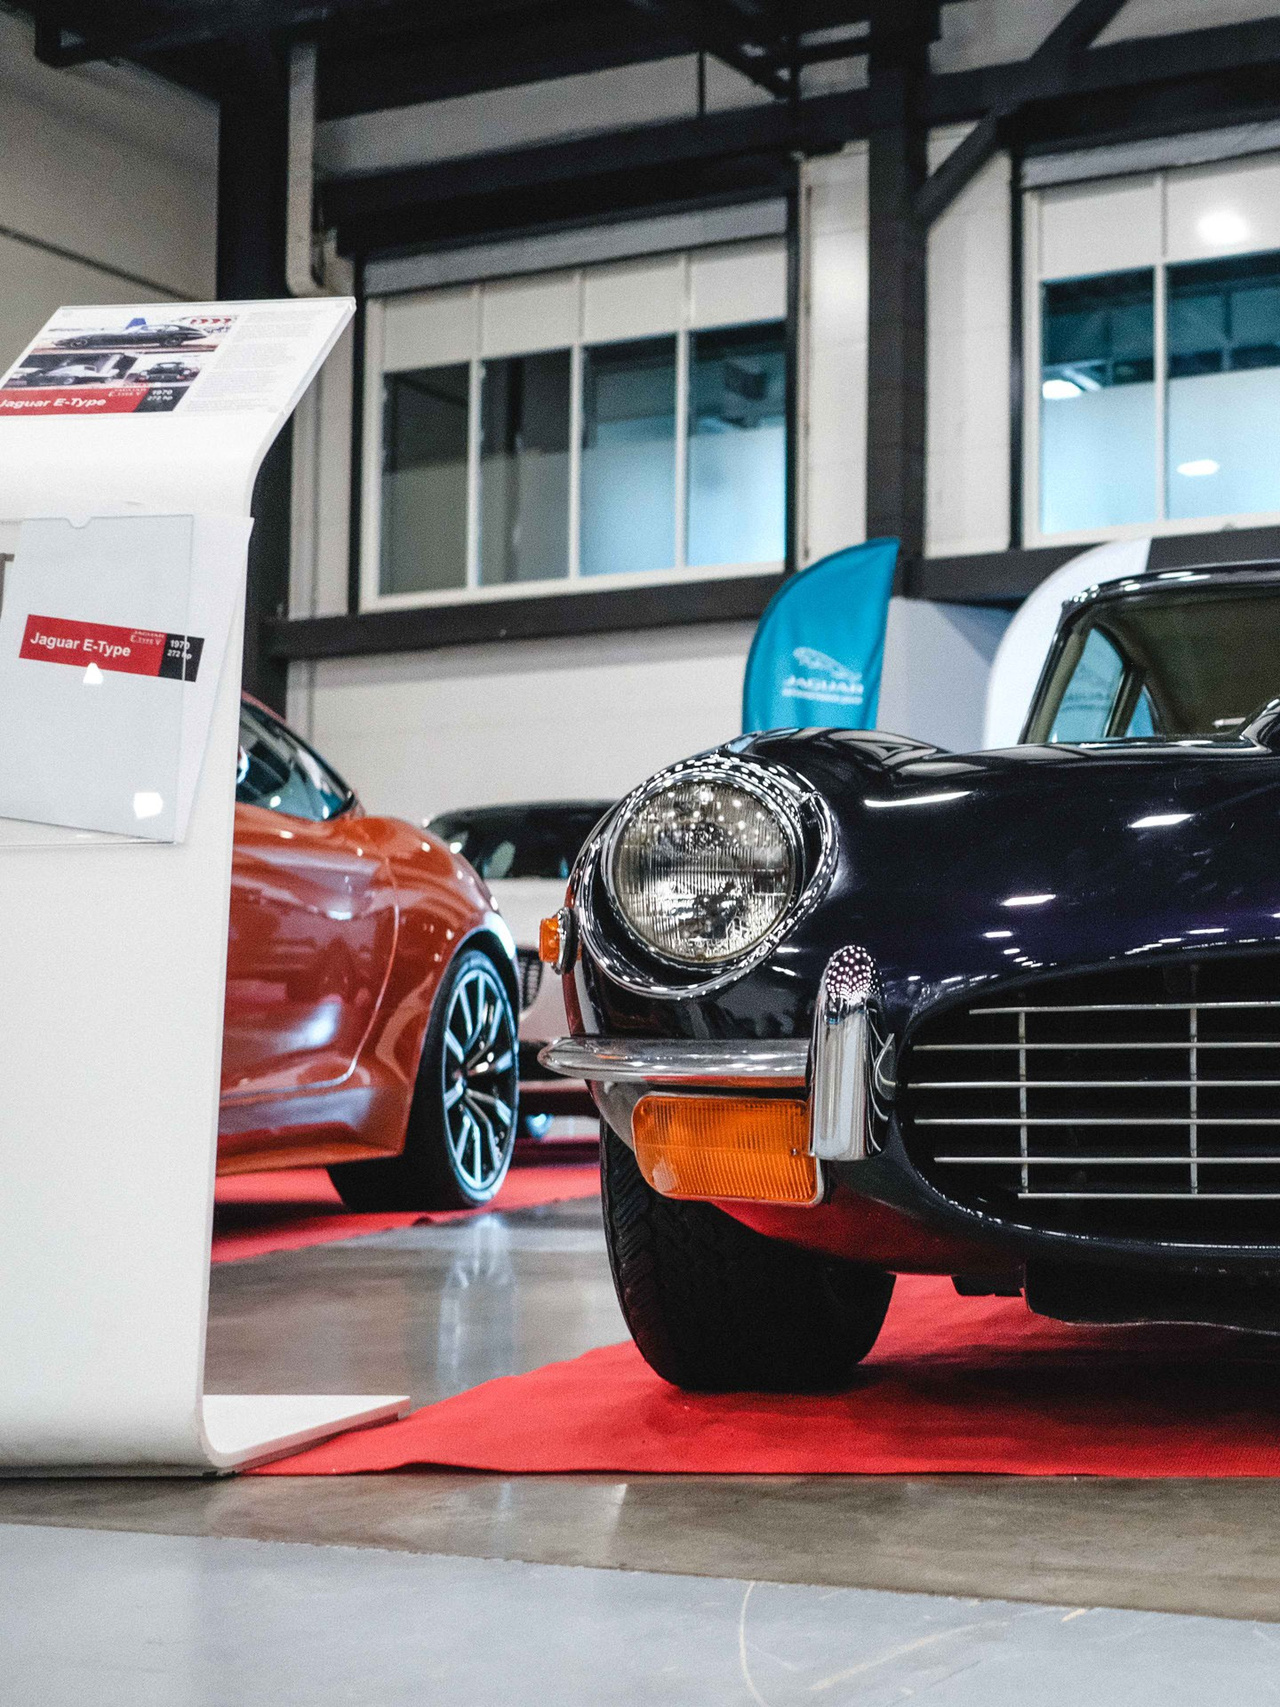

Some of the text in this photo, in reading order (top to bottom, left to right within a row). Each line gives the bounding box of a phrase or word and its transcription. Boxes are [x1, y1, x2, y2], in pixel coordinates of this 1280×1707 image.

[0, 397, 107, 409] Jaguar E-Type
[30, 631, 131, 658] Jaguar E-Type
[170, 639, 191, 650] 1970
